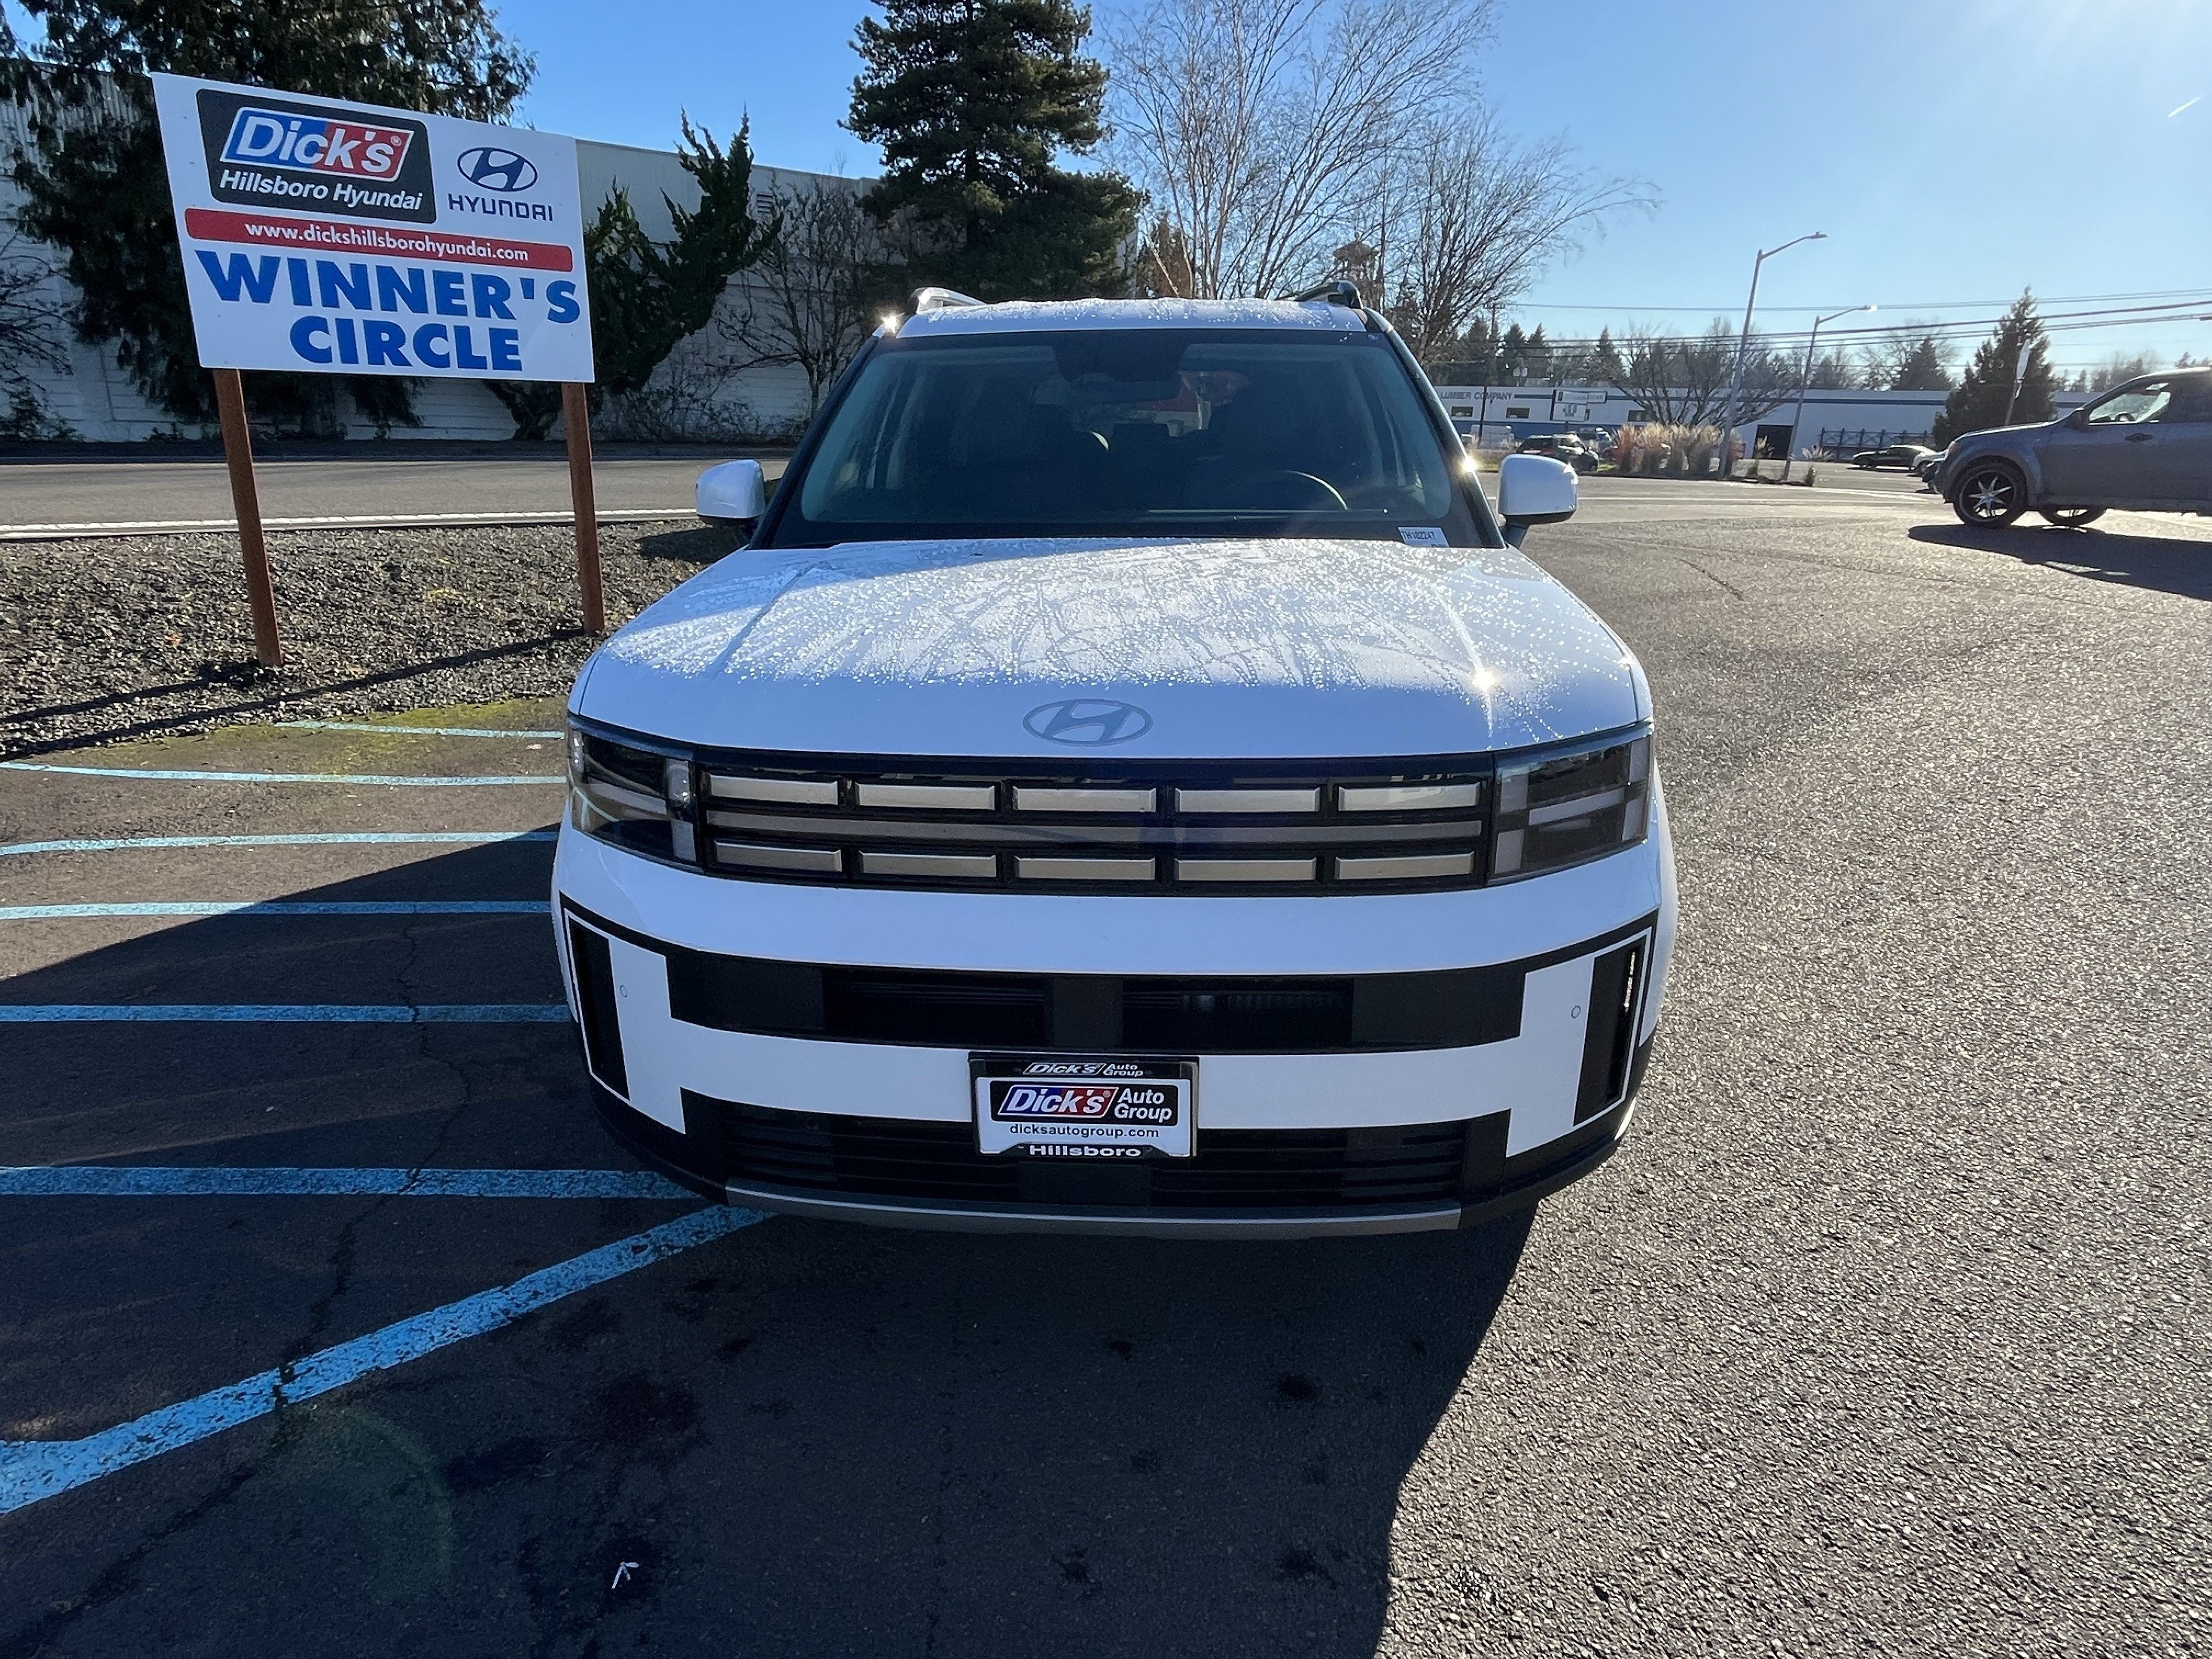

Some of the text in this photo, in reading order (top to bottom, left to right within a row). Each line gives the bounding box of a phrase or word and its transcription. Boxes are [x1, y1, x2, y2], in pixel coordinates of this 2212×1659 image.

[236, 116, 394, 173] Dick's
[219, 169, 424, 211] Hillsboro Hyundai
[448, 193, 554, 222] HYUNDAI
[245, 222, 529, 262] www.dickshillsborohyundai.com
[194, 249, 580, 324] WINNER'S
[290, 315, 522, 371] CIRCLE
[1006, 1088, 1164, 1114] Dick's Auto
[1114, 1104, 1172, 1122] Group
[1010, 1123, 1159, 1138] dicksautogroup.com
[1029, 1144, 1141, 1157] Hillsboro
